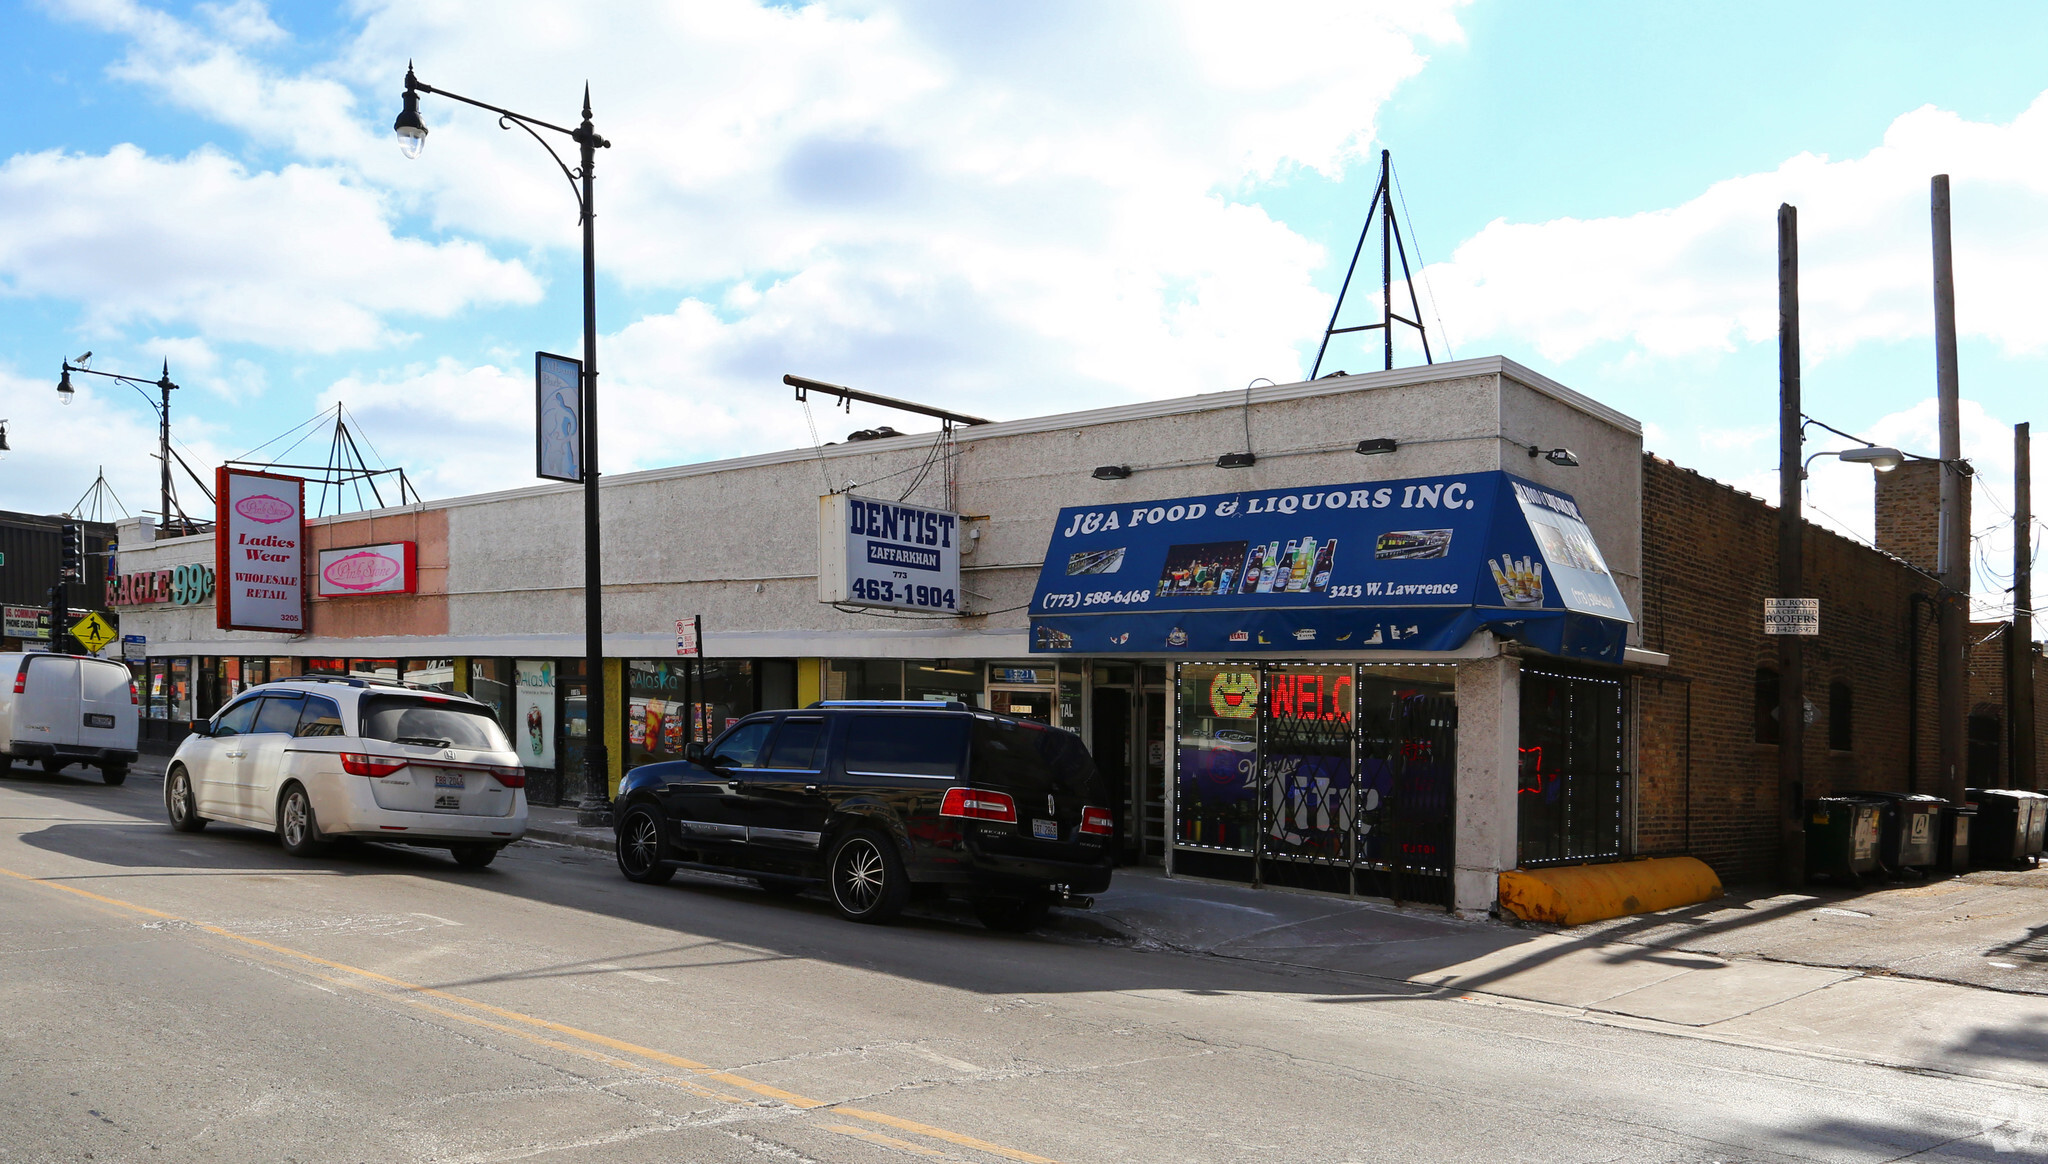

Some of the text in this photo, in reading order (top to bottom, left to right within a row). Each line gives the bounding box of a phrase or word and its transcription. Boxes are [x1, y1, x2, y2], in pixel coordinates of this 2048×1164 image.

[1064, 482, 1475, 538] J&A FOOD & LIQUORS INC.
[850, 500, 955, 548] DENTIST
[238, 533, 295, 548] Ladies
[245, 548, 290, 562] Wear
[870, 546, 937, 567] ZAFFARKHAN
[235, 572, 298, 586] WHOLESALE
[892, 570, 908, 579] 773
[104, 570, 172, 607] EAGLE
[246, 588, 287, 600] RETAIL
[852, 578, 956, 609] 463-1904
[1329, 581, 1459, 598] 3213 W. Lawrence
[1042, 589, 1150, 609] (773) 588-6468
[280, 614, 299, 622] 3205
[1766, 614, 1818, 624] ROOFERS
[635, 671, 678, 689] Alaska
[1271, 674, 1350, 724] WELC
